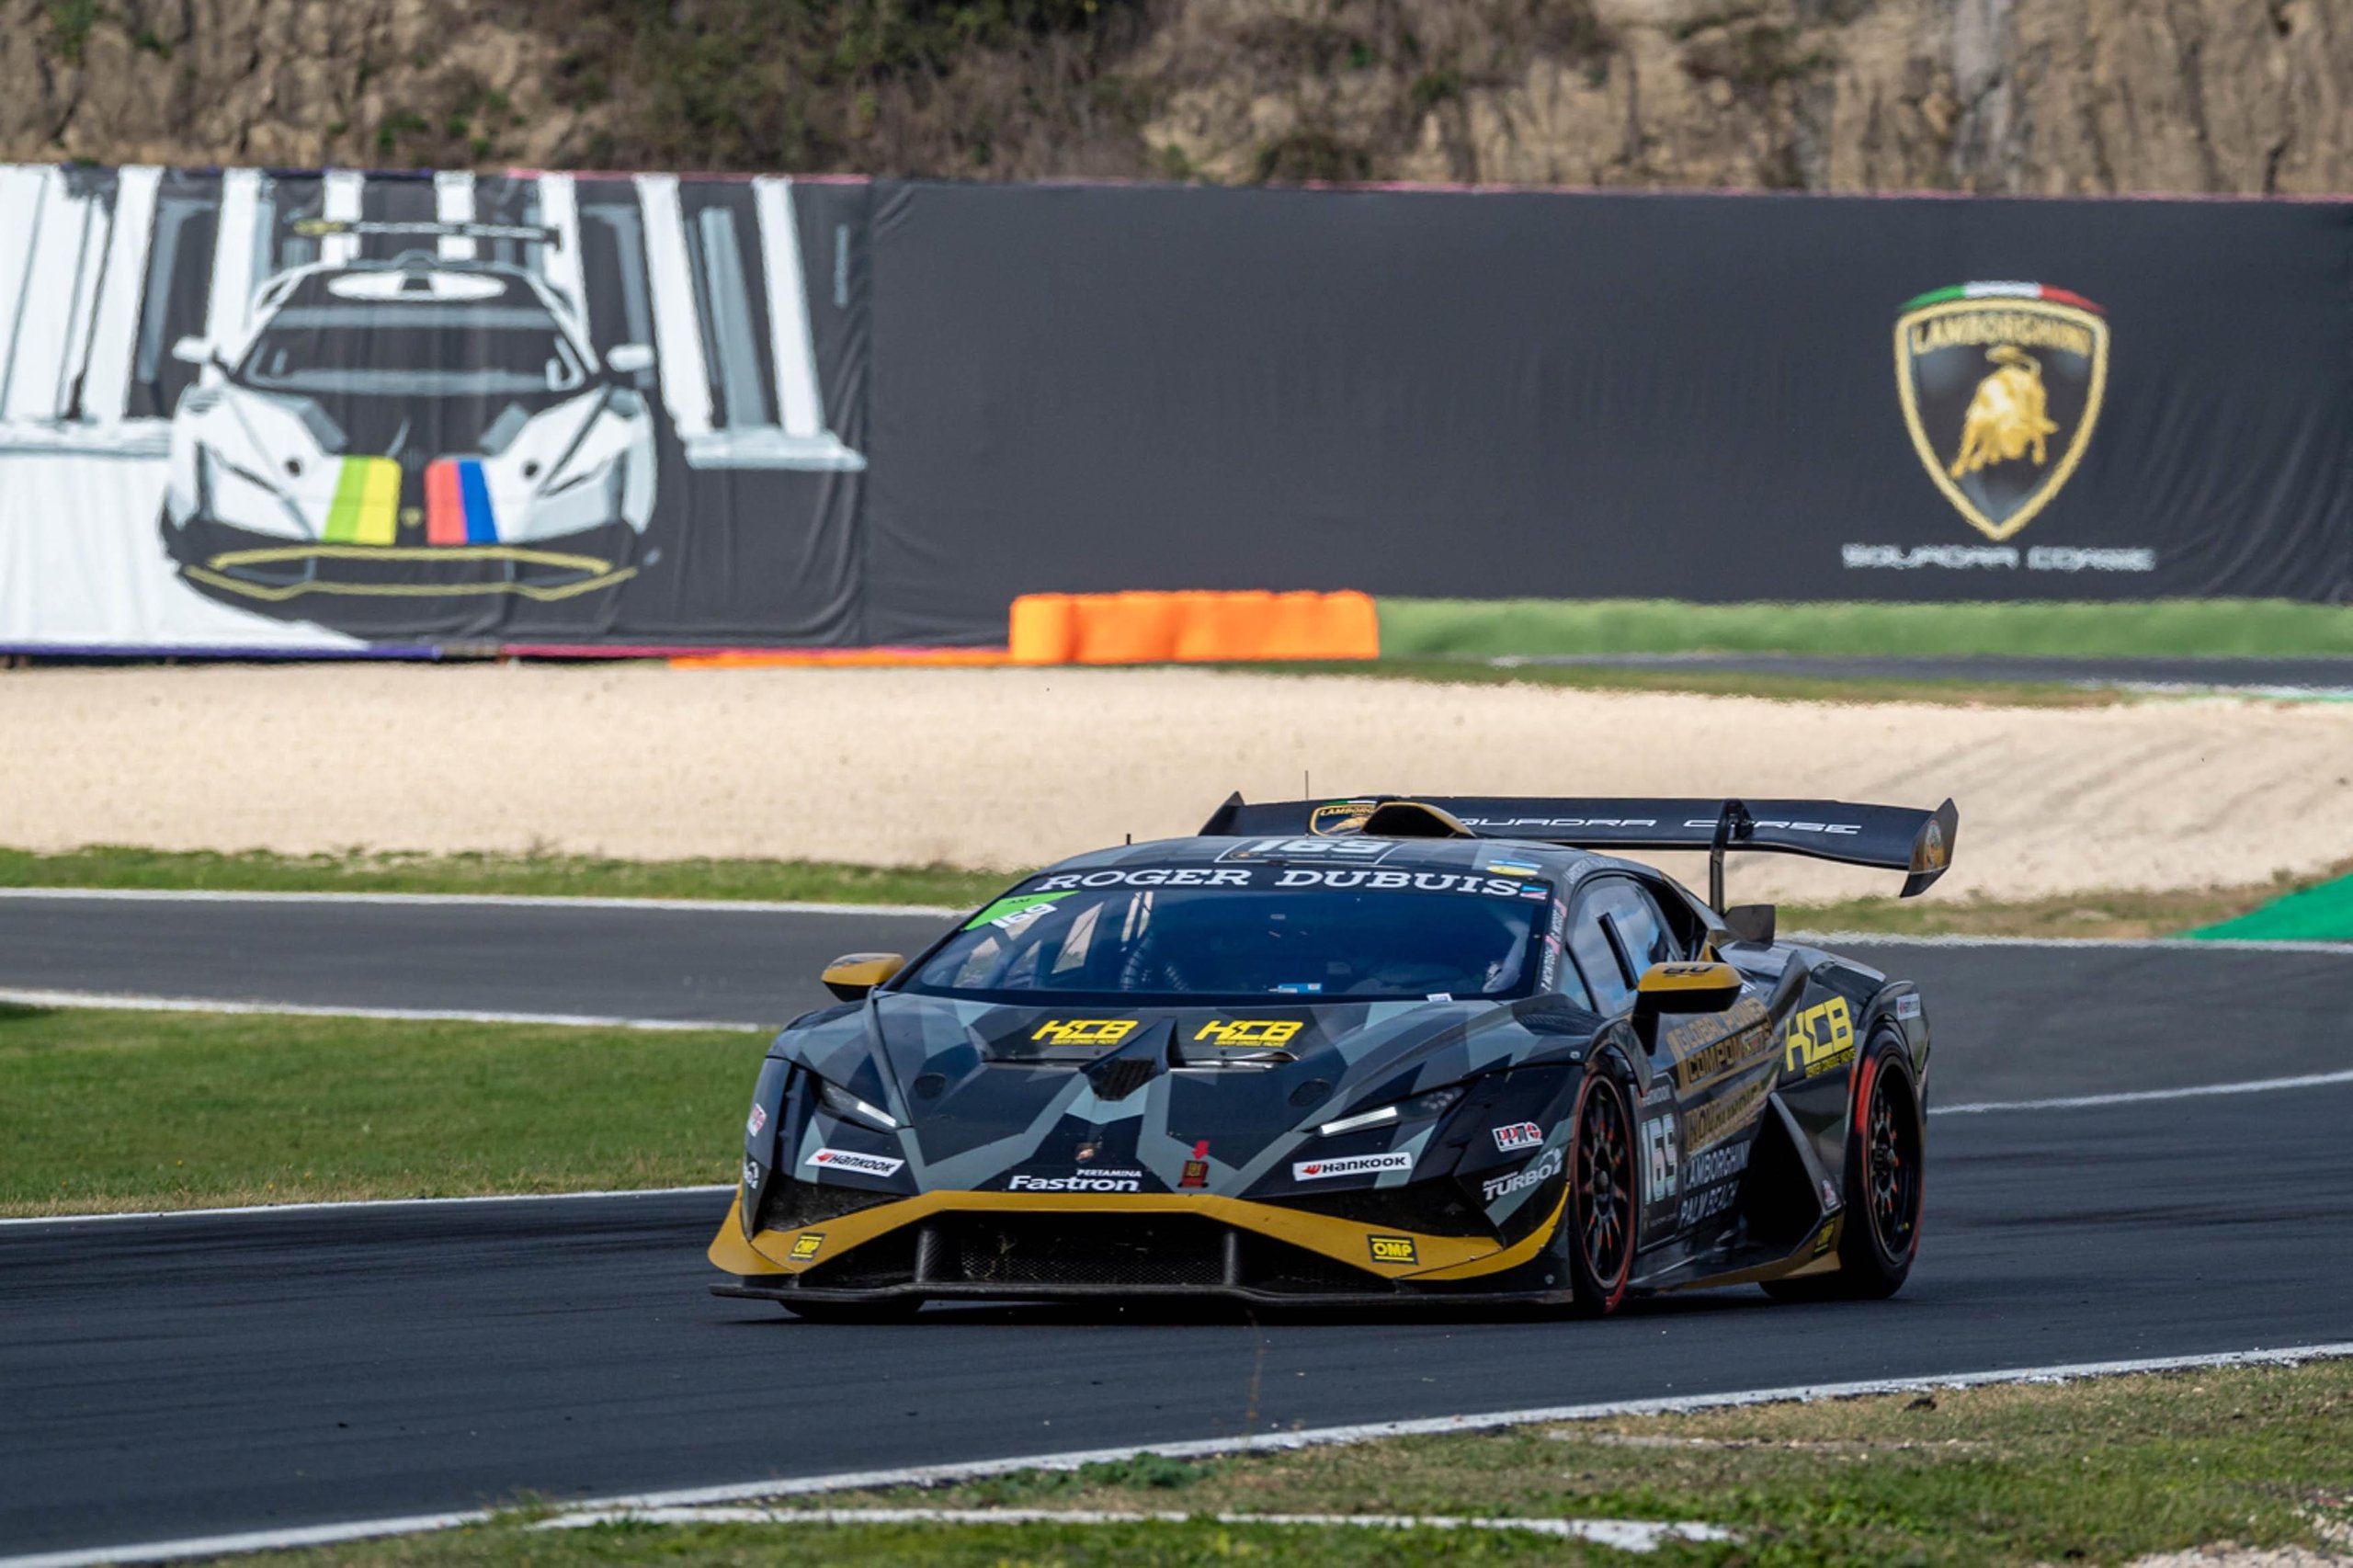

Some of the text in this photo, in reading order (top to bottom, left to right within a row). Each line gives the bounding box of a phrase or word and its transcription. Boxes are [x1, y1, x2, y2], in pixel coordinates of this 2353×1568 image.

[1320, 804, 1377, 816] LAMBORG
[1459, 817, 1861, 835] QUADRA CRSE
[1034, 869, 1522, 898] ROGER DUBUIS
[1031, 1020, 1139, 1040] HCB
[1194, 1020, 1303, 1041] HCB
[1786, 995, 1854, 1073] HCB
[1076, 1169, 1142, 1177] PERTAMINA
[1483, 1163, 1552, 1201] TURBO
[1008, 1175, 1140, 1192] Fastron
[1372, 1242, 1414, 1257] OMP
